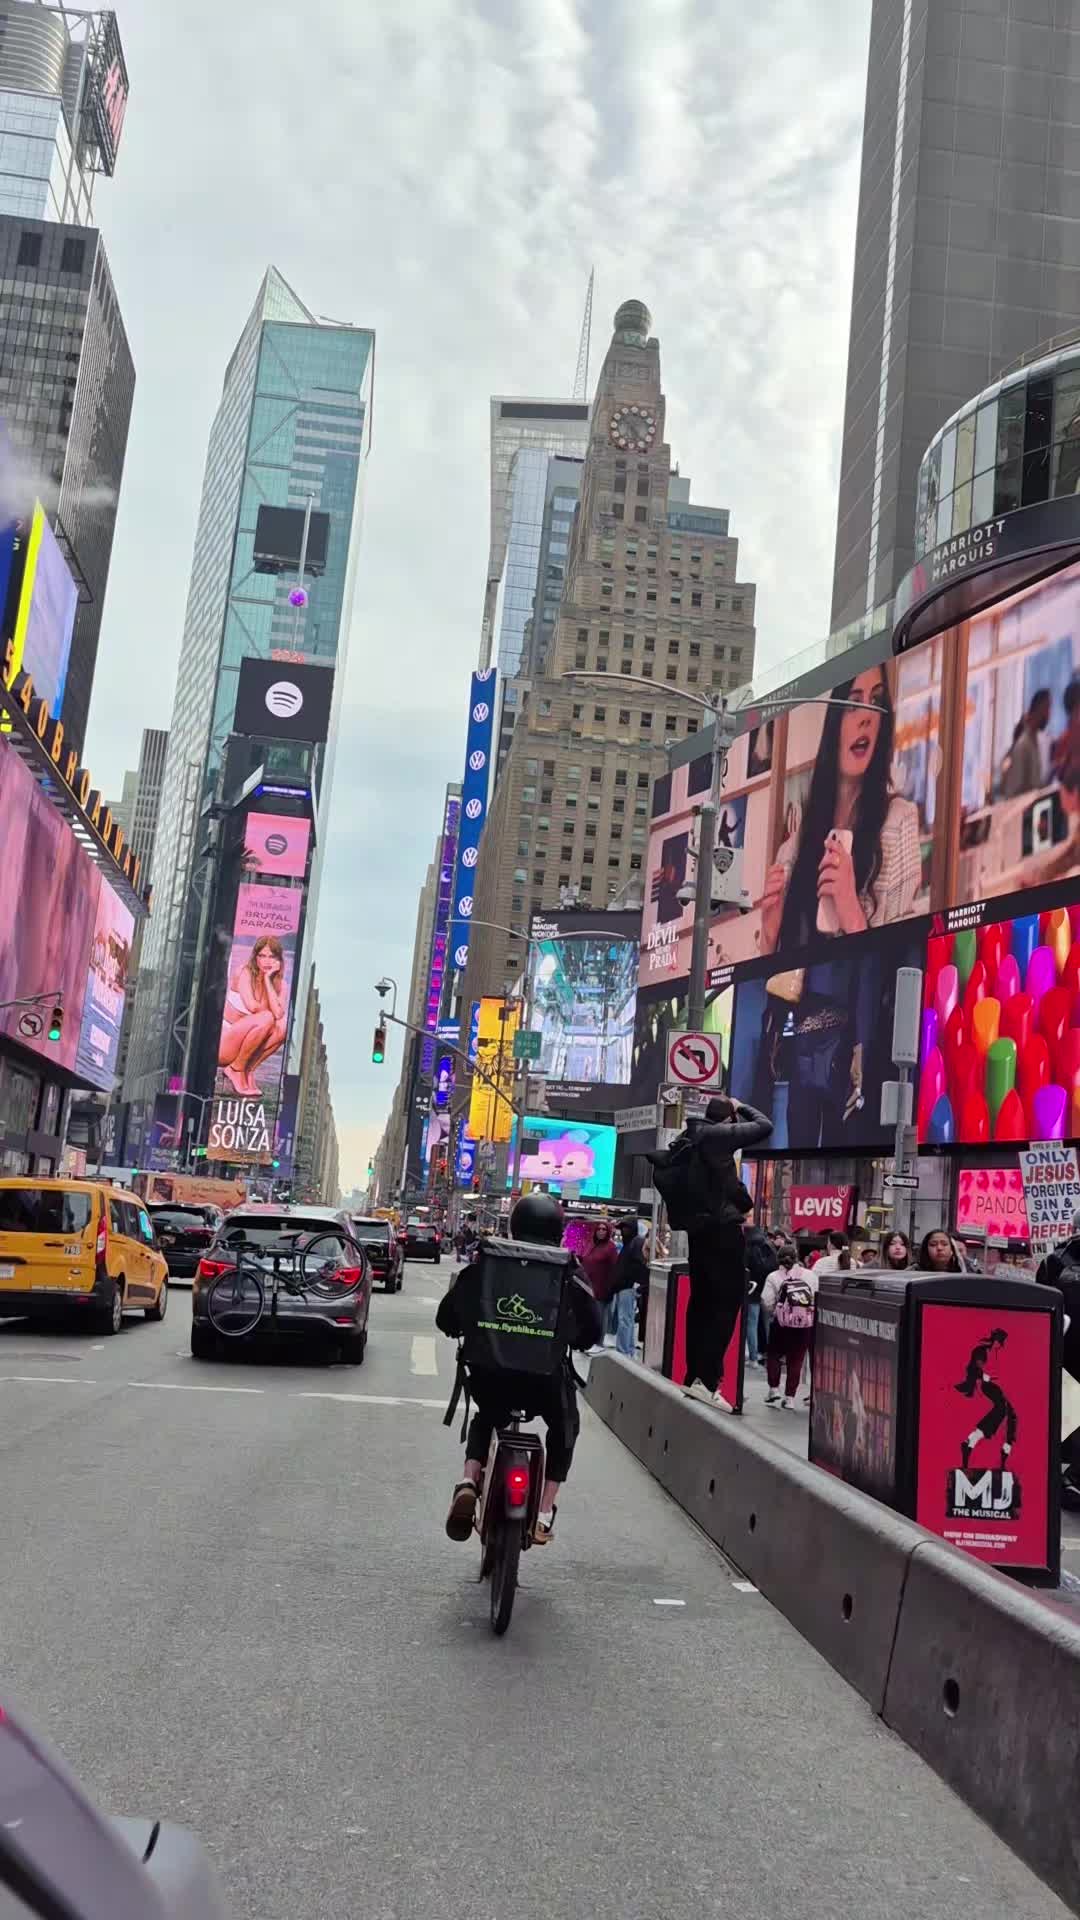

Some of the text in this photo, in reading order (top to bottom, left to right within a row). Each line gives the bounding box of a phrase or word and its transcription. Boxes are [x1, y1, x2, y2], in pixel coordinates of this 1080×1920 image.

[933, 520, 1005, 563] MARRIOTT
[932, 543, 993, 581] MARQUIS
[51, 720, 141, 887] BROADWAY
[245, 911, 291, 922] BRUTAL
[948, 903, 986, 919] MARRIOTT
[948, 915, 981, 930] MARQUIS
[647, 926, 679, 950] DEVIL
[649, 952, 677, 971] PRADA
[217, 1097, 266, 1128] LUÍSA
[209, 1124, 270, 1152] SONZA
[1025, 1150, 1071, 1165] ONLY
[1025, 1162, 1076, 1184] JESUS
[1024, 1182, 1080, 1198] FORGIVES
[976, 1196, 1027, 1215] PANDO
[1034, 1197, 1073, 1211] SIN &
[1031, 1222, 1075, 1239] REPEN
[955, 1468, 1014, 1511] MJ
[952, 1508, 1012, 1519] THE MUSICAL
